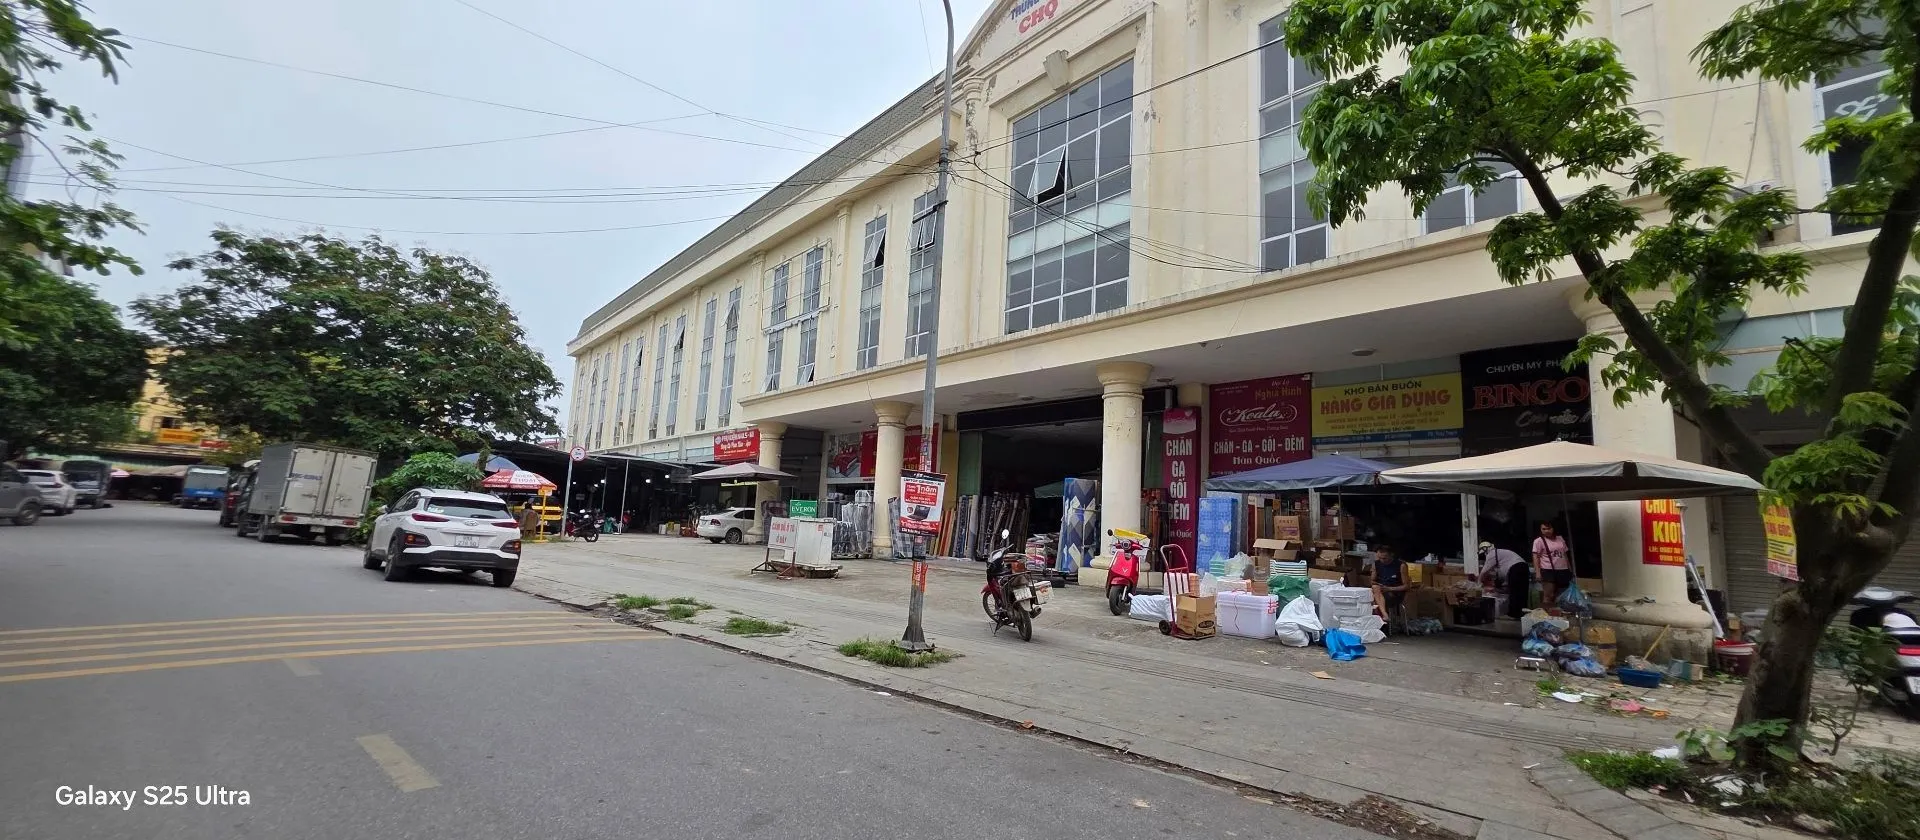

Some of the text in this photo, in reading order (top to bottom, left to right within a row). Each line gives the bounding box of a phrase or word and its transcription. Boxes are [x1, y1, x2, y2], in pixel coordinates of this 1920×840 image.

[1320, 389, 1451, 414] HÀNG GIA DỤNG
[1344, 387, 1364, 396] KHO
[1472, 376, 1590, 410] BINGO
[1165, 436, 1193, 456] CHĂN
[1214, 438, 1234, 454] CHĂN
[1242, 439, 1253, 453] GA
[1171, 460, 1186, 478] GA
[1169, 478, 1187, 499] GỐI
